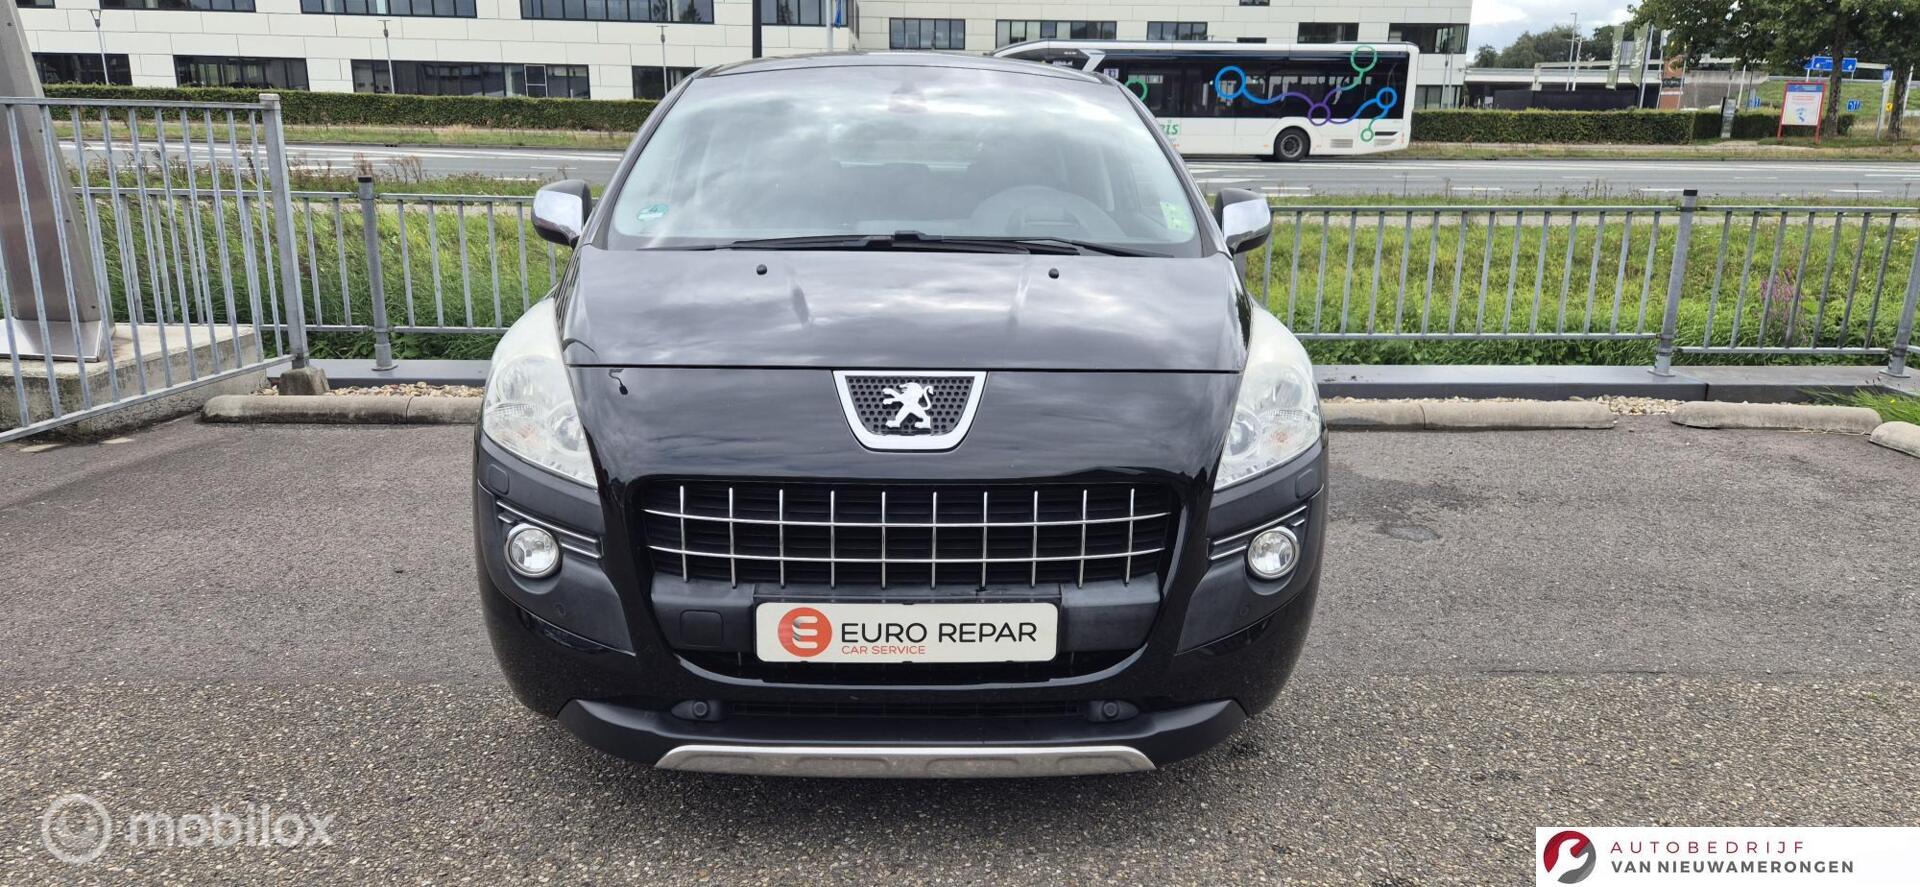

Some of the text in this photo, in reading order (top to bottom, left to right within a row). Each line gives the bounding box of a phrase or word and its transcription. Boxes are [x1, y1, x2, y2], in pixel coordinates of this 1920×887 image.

[841, 622, 1037, 643] EURO REPAR
[841, 646, 926, 655] CAR SERVICE
